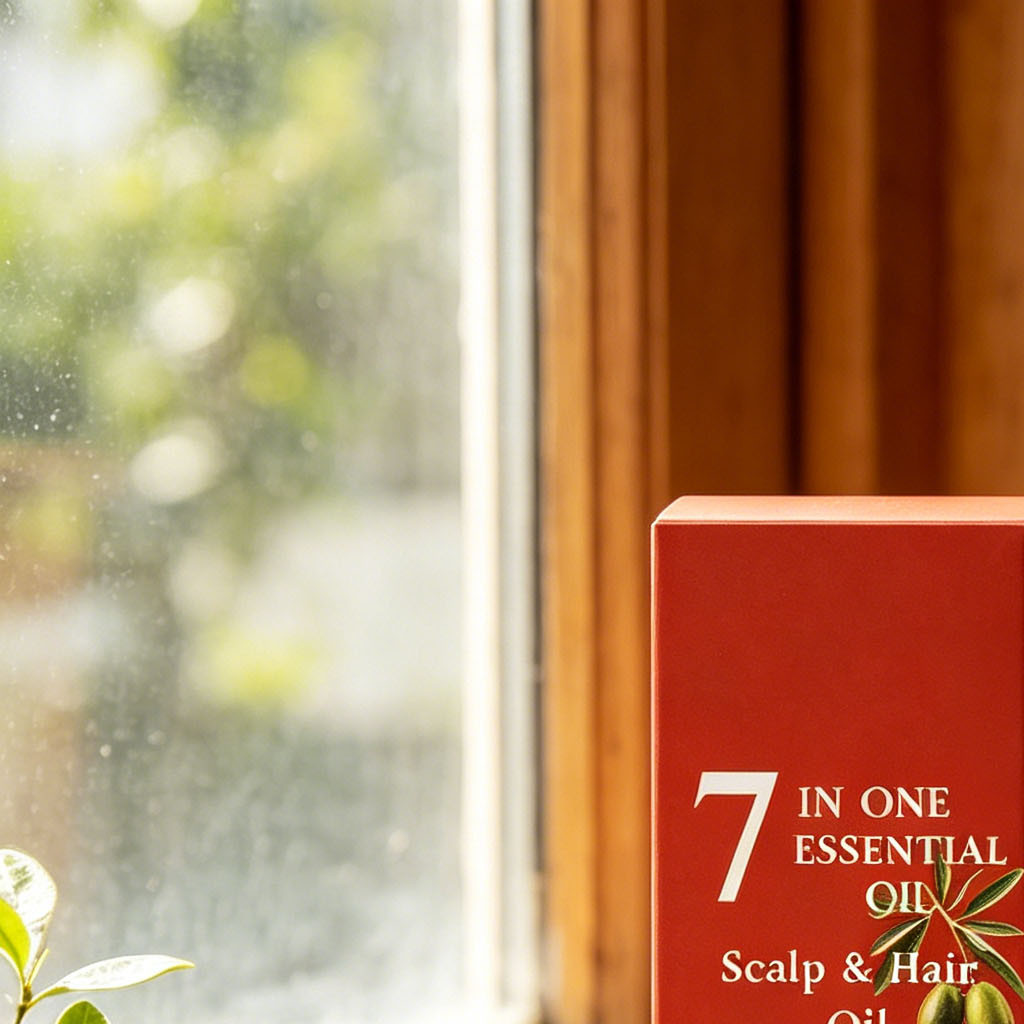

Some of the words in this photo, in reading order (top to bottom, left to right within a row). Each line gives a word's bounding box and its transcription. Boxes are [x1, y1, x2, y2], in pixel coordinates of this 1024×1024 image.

[694, 771, 779, 902] 7
[798, 786, 845, 818] IN
[860, 785, 951, 818] ONE
[793, 834, 1008, 866] ESSENTIAL
[865, 880, 937, 914] OIL
[721, 949, 826, 996] Scalp
[842, 951, 874, 984] &
[890, 951, 979, 985] Hair
